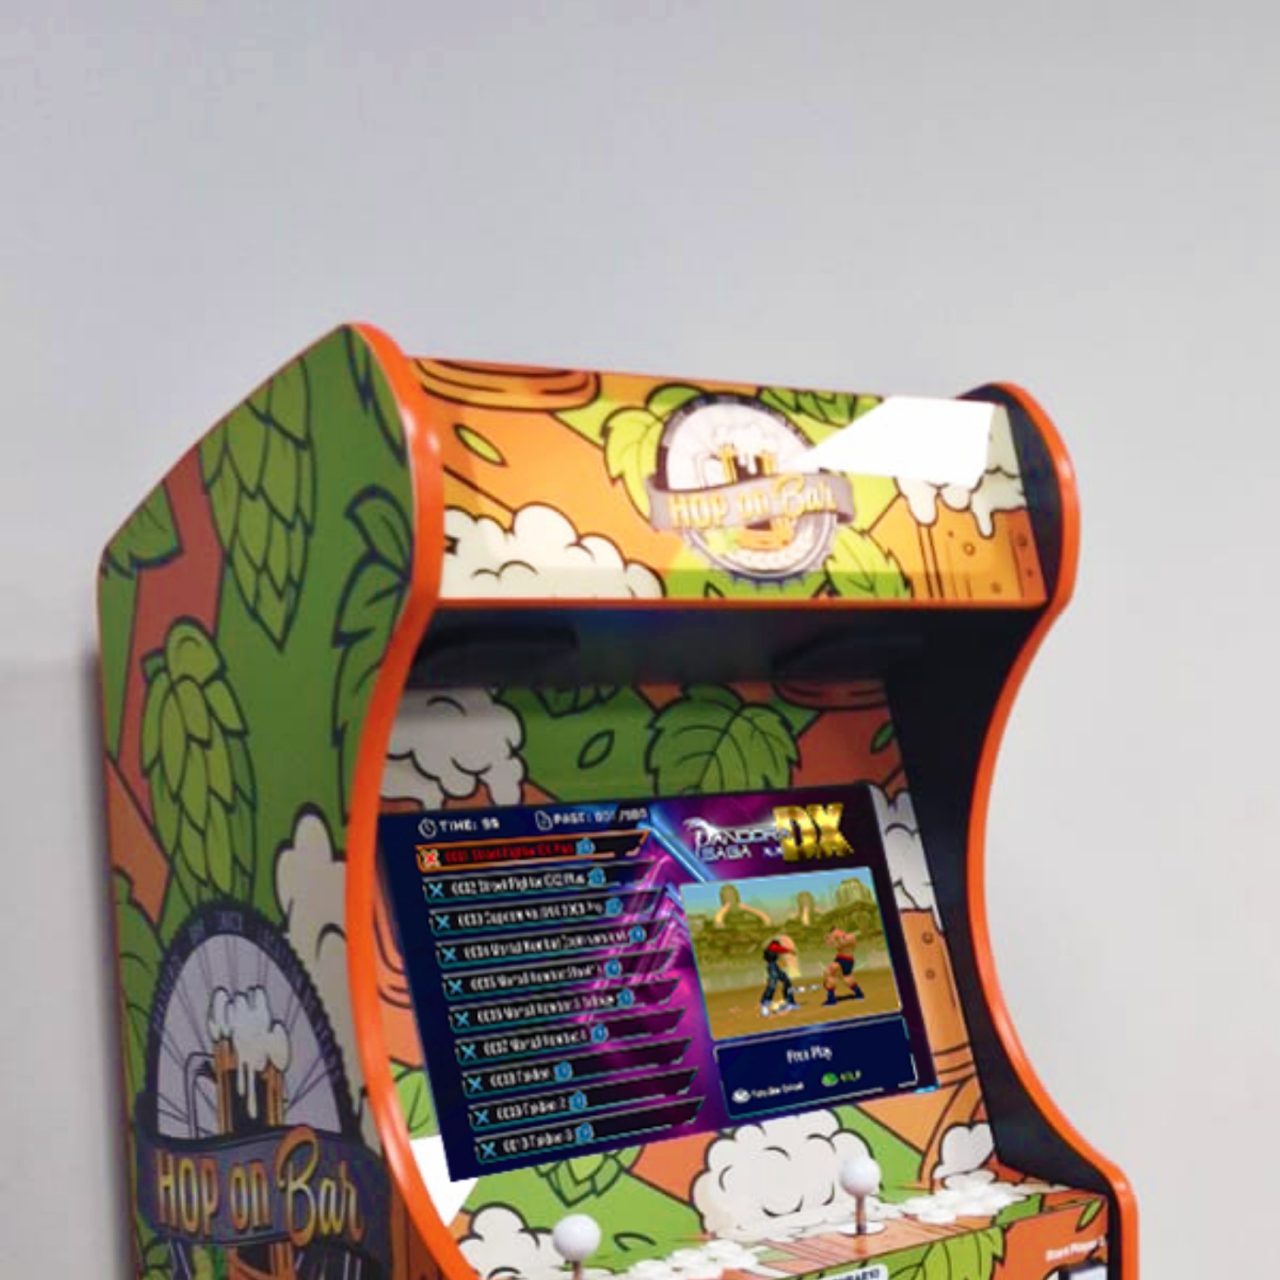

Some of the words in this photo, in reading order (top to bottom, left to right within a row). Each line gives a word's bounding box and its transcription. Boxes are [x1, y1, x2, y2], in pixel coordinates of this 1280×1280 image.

[669, 492, 726, 529] HOP
[773, 802, 855, 861] DX
[155, 1148, 220, 1236] HOP
[229, 1158, 273, 1232] on
[274, 1124, 367, 1248] Bar
